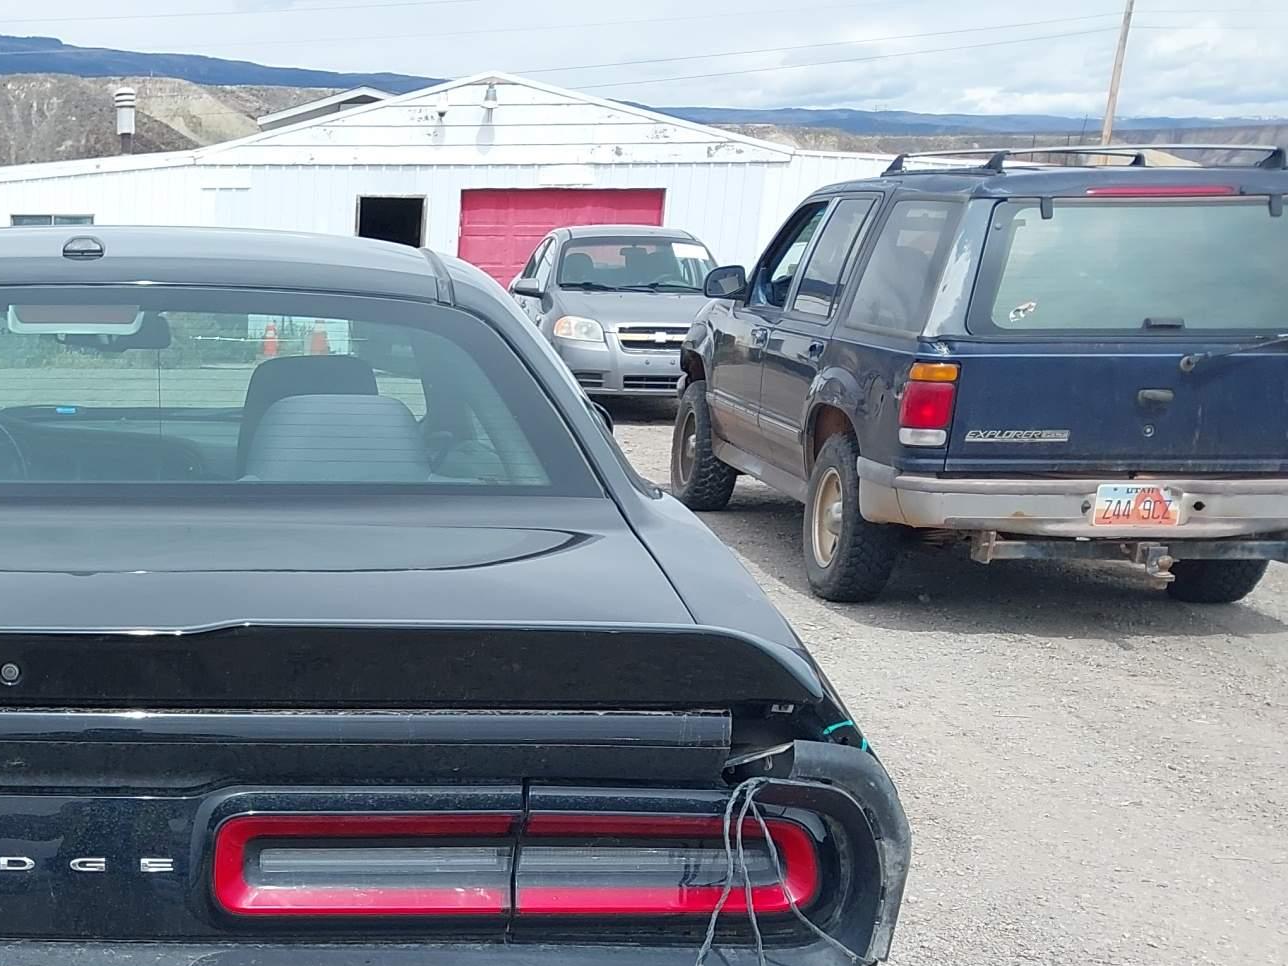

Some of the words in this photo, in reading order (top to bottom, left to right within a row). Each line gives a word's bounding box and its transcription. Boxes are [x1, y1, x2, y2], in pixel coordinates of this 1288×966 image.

[965, 429, 1042, 440] EXPLORER
[1102, 499, 1132, 520] Z44
[1141, 499, 1173, 520] 9CZ
